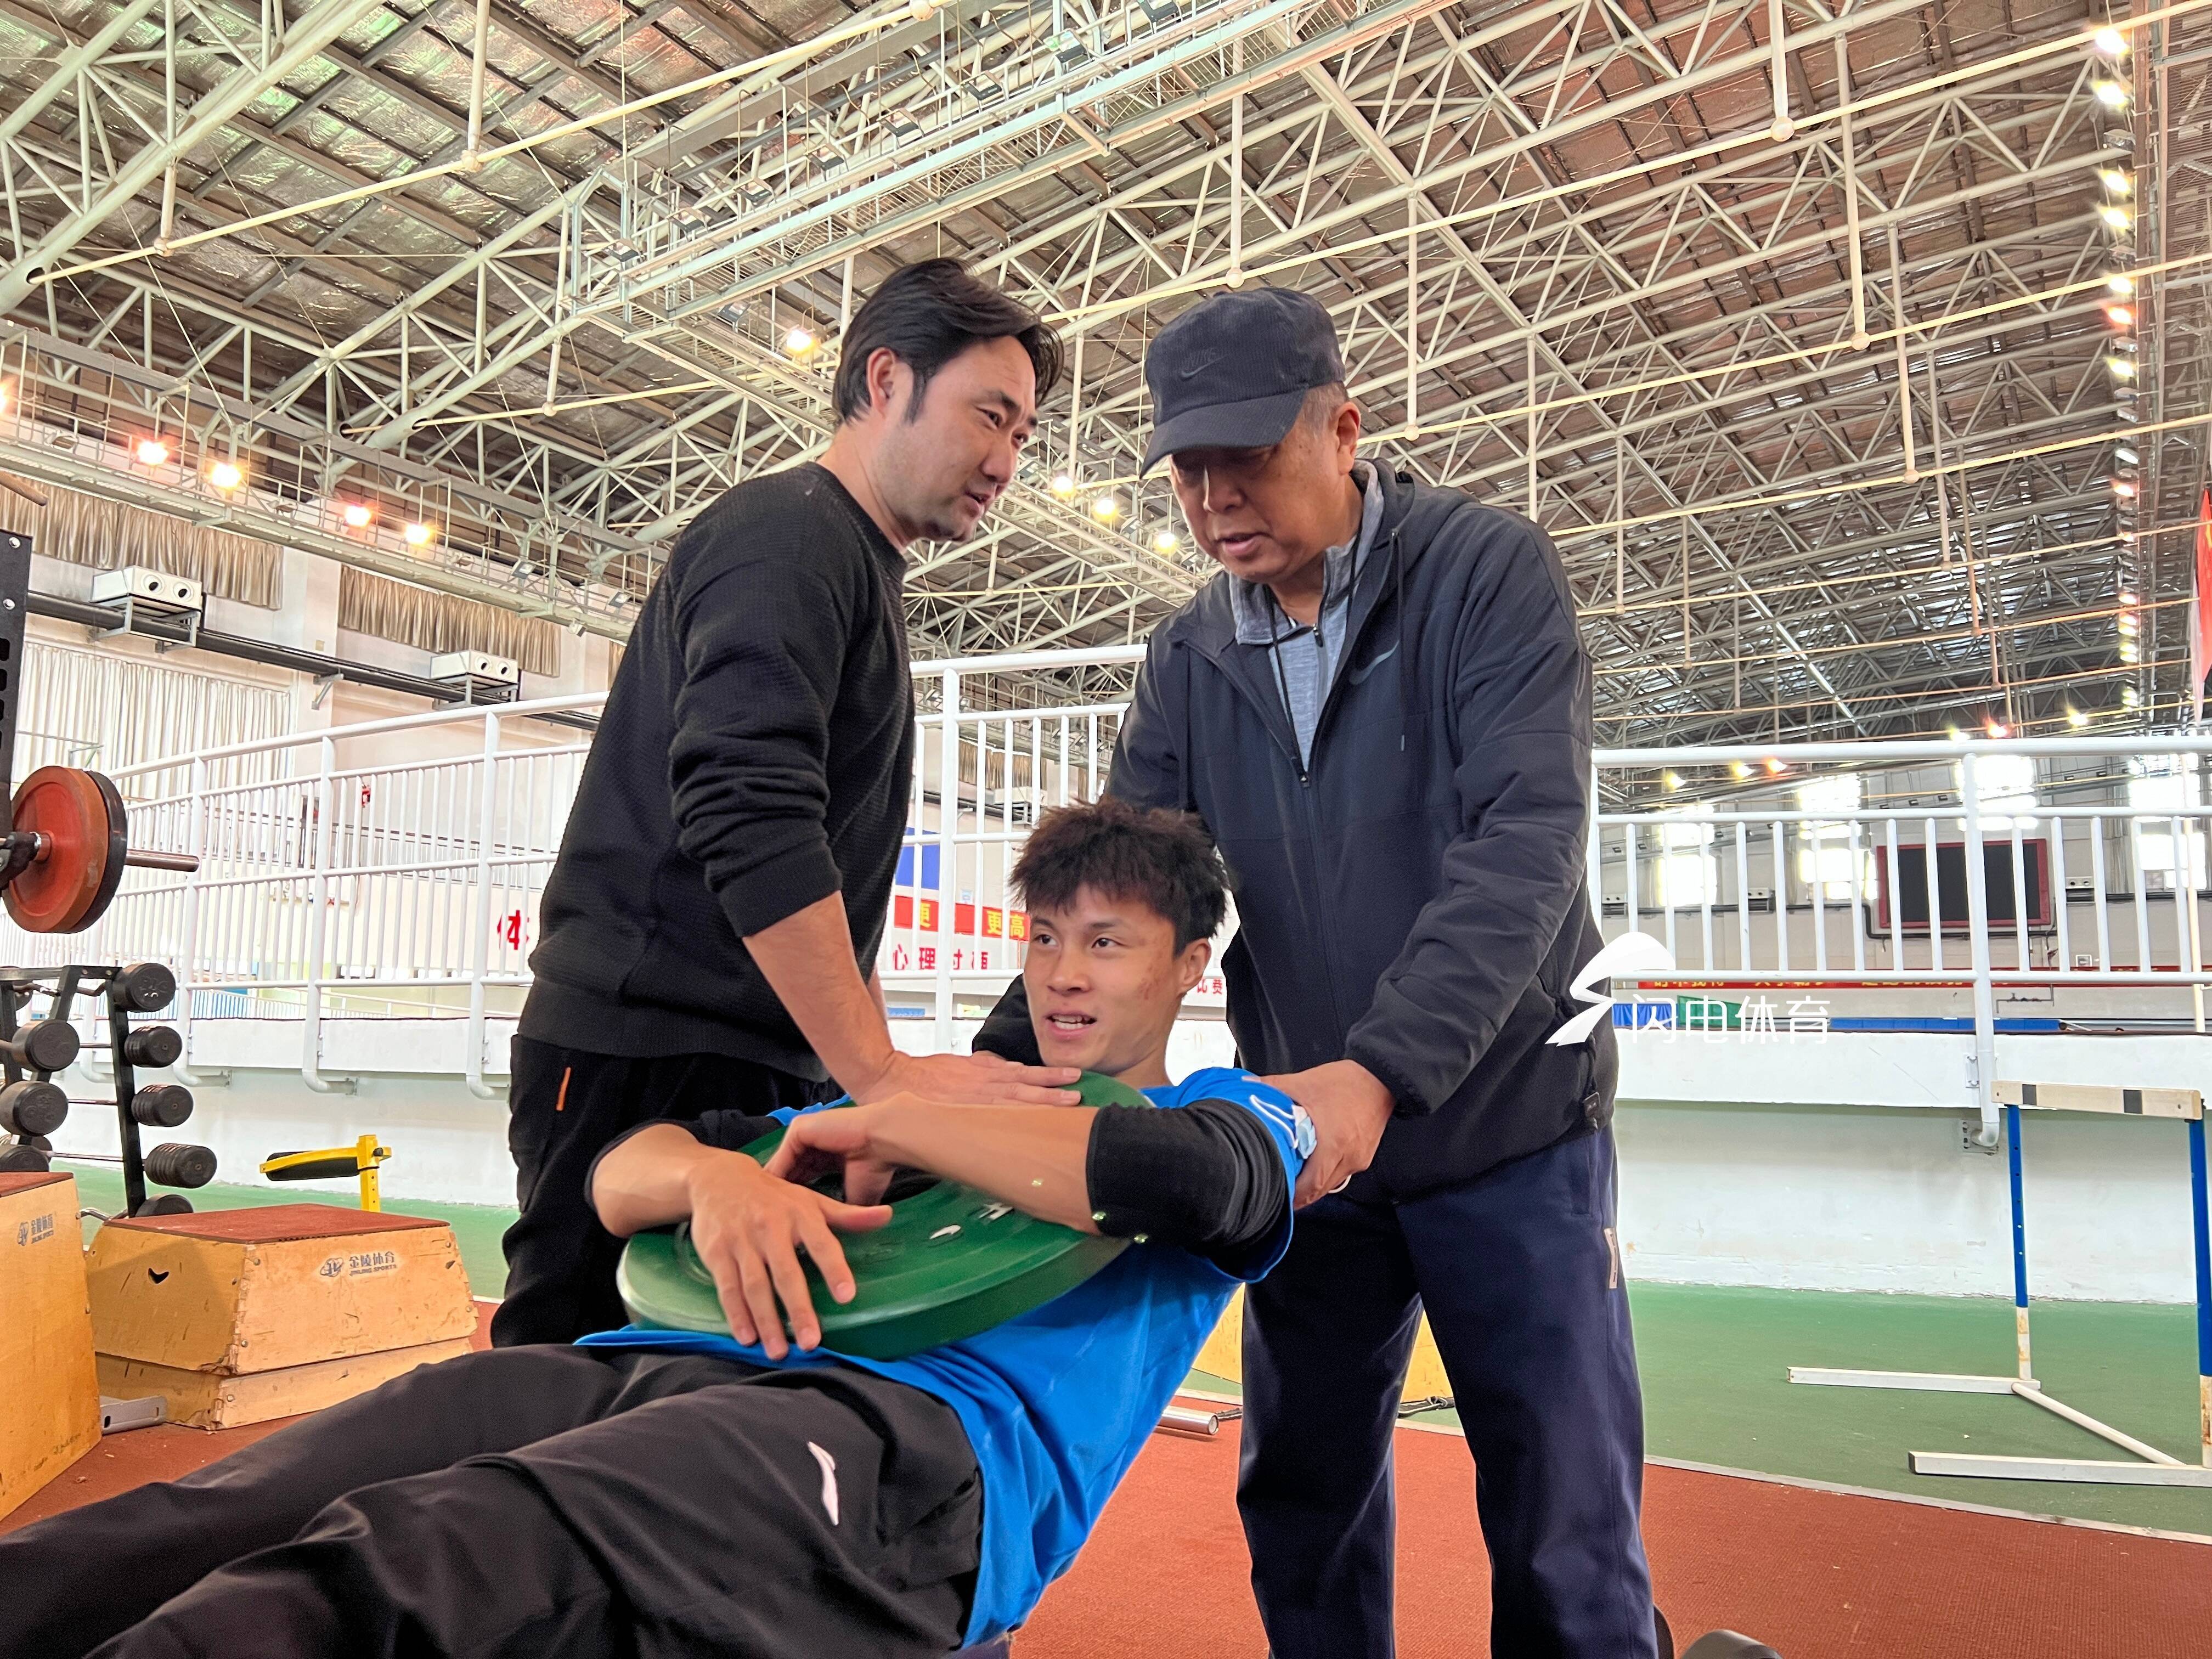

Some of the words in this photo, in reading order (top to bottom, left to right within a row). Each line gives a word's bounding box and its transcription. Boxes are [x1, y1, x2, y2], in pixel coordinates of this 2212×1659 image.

[497, 910, 529, 950] 体
[987, 910, 1025, 938] 更高
[349, 1251, 394, 1268] 金陵体育
